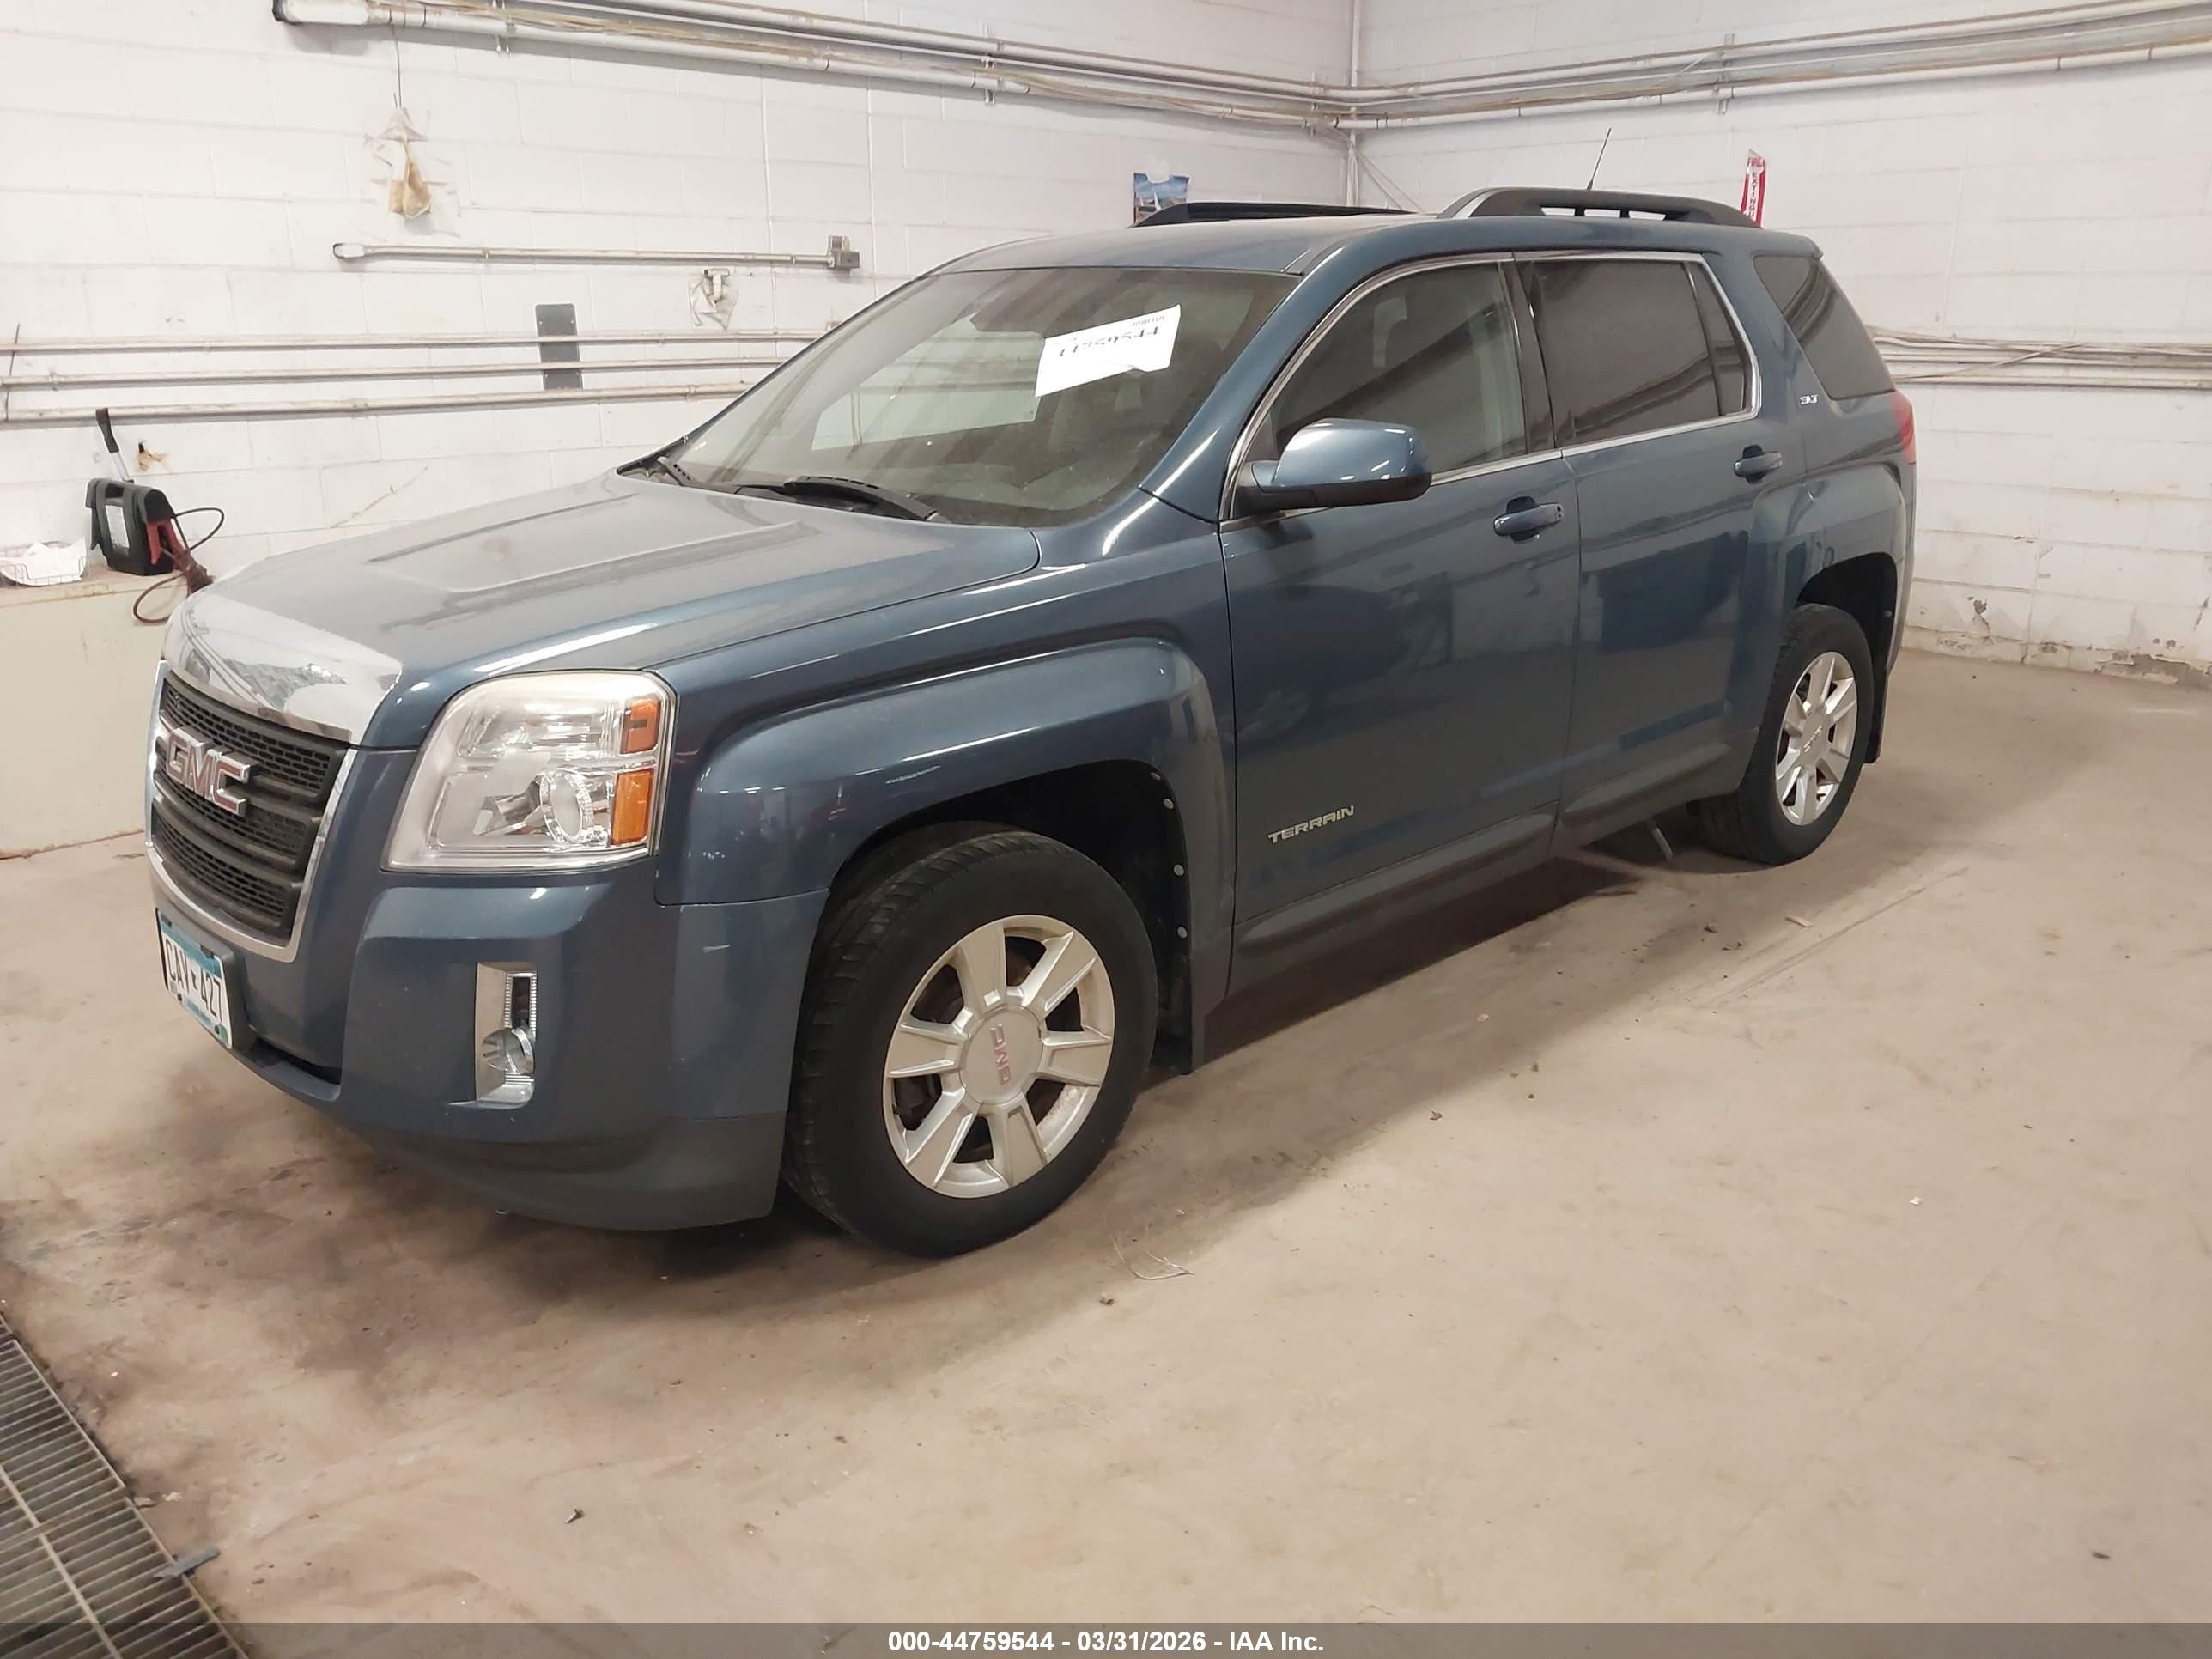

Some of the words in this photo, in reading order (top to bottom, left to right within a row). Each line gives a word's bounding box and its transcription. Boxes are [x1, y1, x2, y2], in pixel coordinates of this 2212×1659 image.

[165, 730, 252, 817] GMC
[1267, 805, 1355, 844] TERRAIN
[199, 968, 223, 1023] 427
[989, 1023, 1012, 1086] GMC
